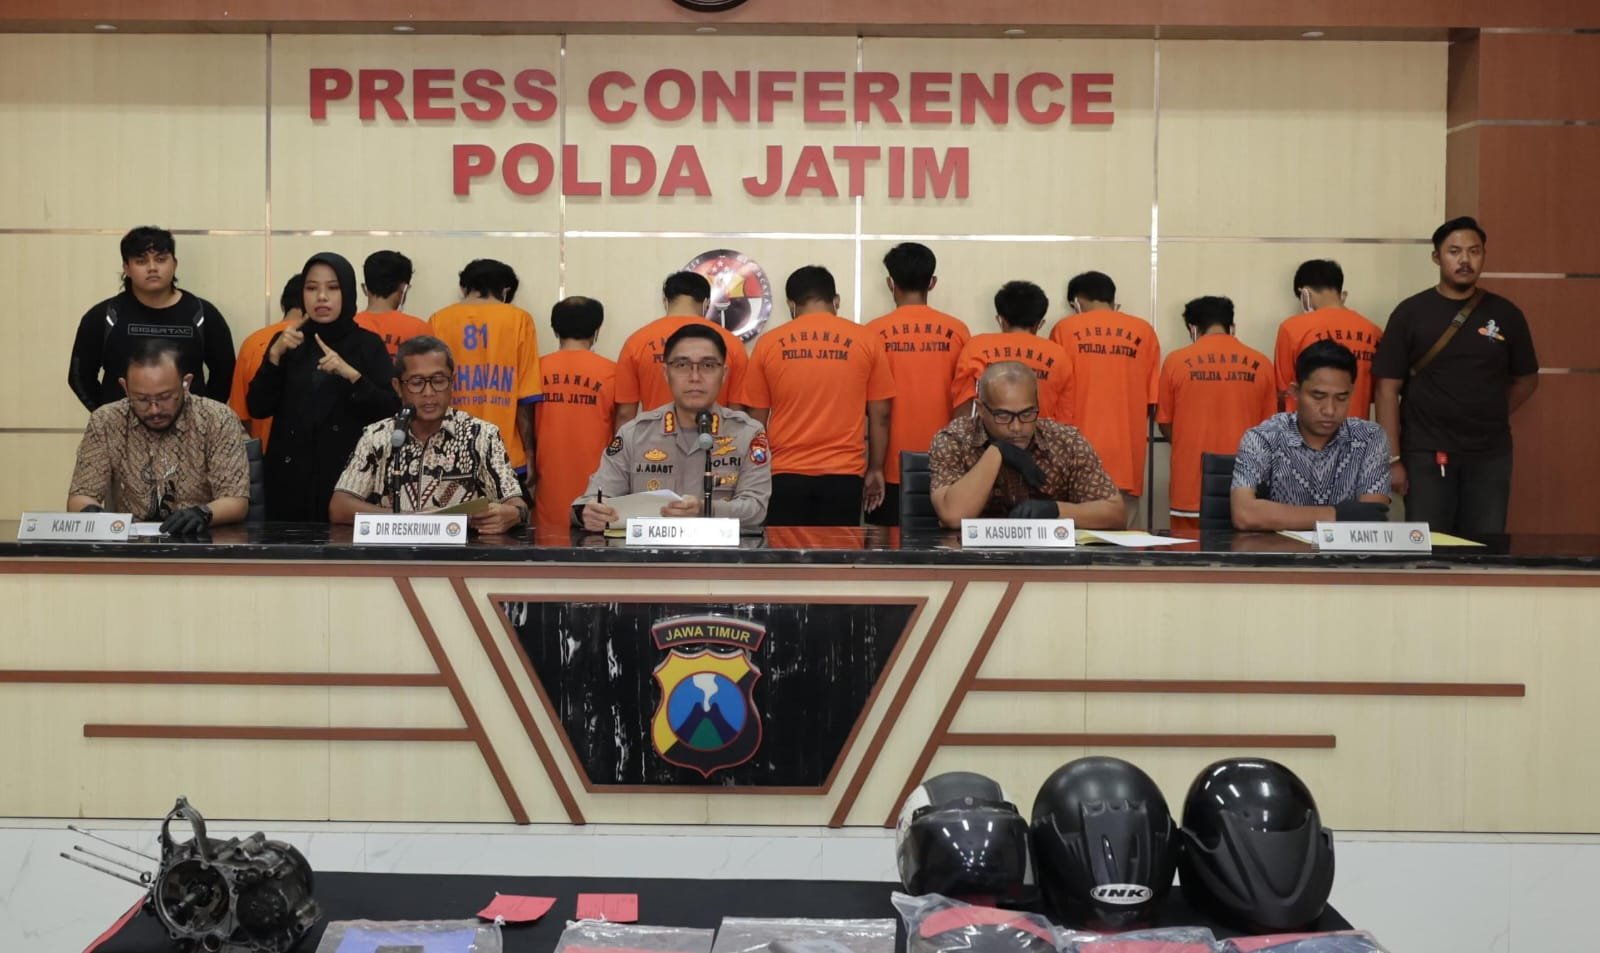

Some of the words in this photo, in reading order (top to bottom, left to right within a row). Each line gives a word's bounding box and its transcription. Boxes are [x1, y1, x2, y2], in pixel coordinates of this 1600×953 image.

[310, 68, 557, 121] PRESS
[588, 69, 1114, 125] CONFERENCE
[454, 144, 710, 197] POLDA
[743, 146, 969, 198] JATIM
[463, 323, 488, 350] 81
[880, 323, 954, 339] TAHANAN
[1073, 327, 1142, 347] TAHANAN
[778, 331, 853, 348] TAHANAN
[885, 342, 915, 352] POLDA
[919, 342, 950, 352] JATIM
[782, 349, 813, 360] POLDA
[816, 349, 849, 360] JATIM
[982, 346, 1054, 368] TAHANAN
[1078, 343, 1106, 354] POLDA
[1109, 345, 1137, 359] JATIM
[1184, 353, 1260, 370] TAHANAN
[543, 374, 602, 392] AHANAN
[1190, 371, 1221, 381] POLDA
[1224, 371, 1256, 382] JATIM
[567, 393, 597, 406] JATIM
[712, 457, 741, 467] OLRI
[51, 519, 81, 533] KANIT
[84, 519, 95, 533] III
[376, 522, 390, 535] DIR
[391, 522, 441, 536] RESKRIMUM
[648, 525, 677, 538] KABID
[985, 526, 1033, 539] KASUBDIT
[1037, 527, 1047, 539] III
[1350, 529, 1378, 543] KANIT
[1383, 530, 1393, 543] IV
[665, 625, 704, 641] JAWA
[707, 625, 751, 643] TIMUR
[1097, 888, 1146, 898] INK
